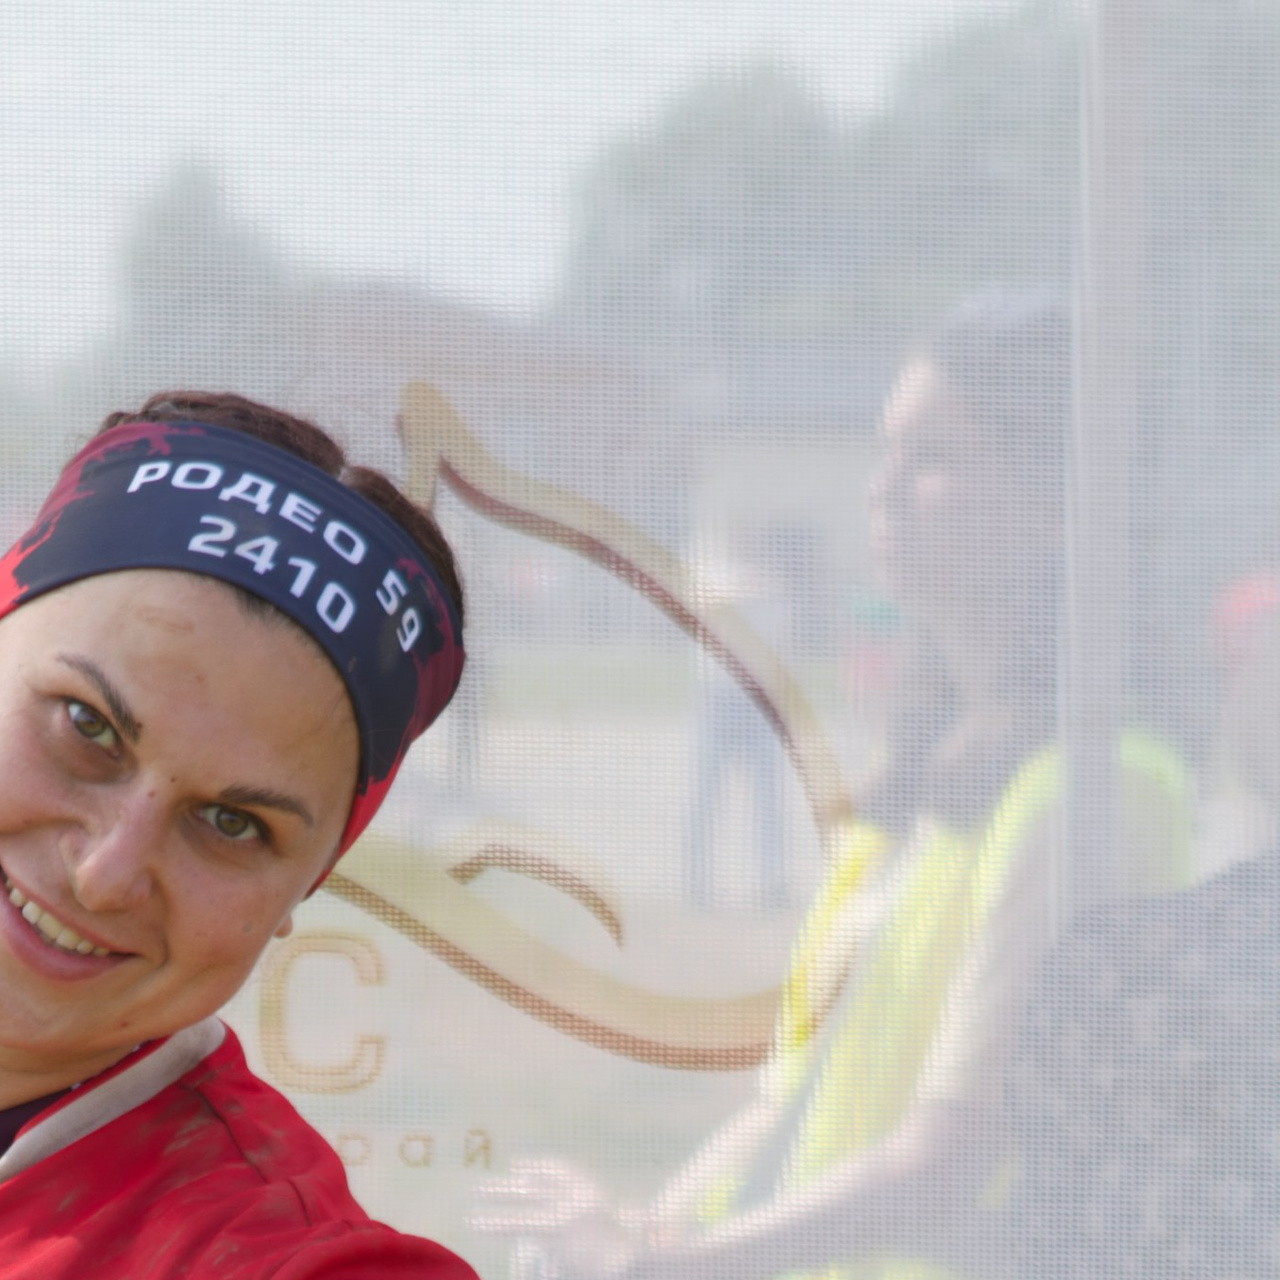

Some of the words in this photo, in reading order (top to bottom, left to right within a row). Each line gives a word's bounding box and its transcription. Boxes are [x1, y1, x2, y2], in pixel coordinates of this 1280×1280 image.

[126, 461, 368, 566] РОДЕО
[375, 568, 422, 653] 59
[187, 514, 357, 635] 2410
